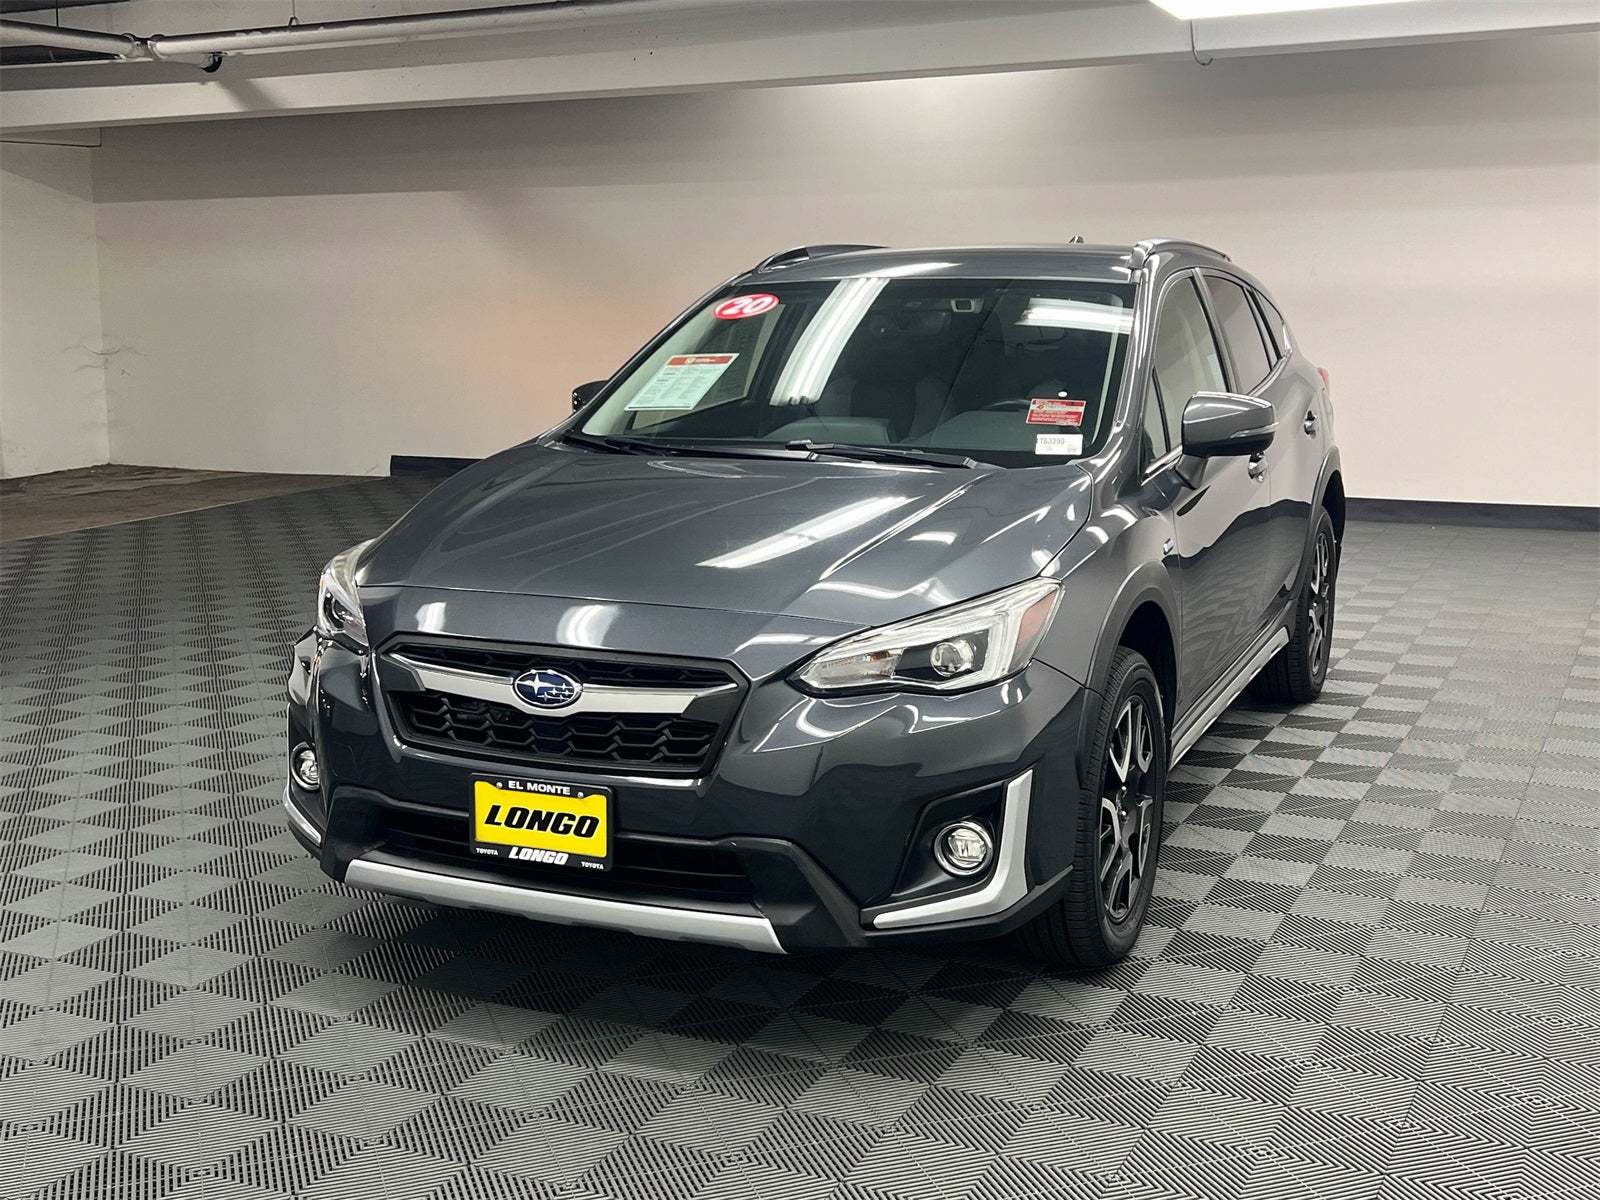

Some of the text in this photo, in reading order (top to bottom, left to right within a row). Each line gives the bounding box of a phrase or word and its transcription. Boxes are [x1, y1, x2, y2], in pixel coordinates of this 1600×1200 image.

[721, 296, 774, 316] 20
[508, 780, 571, 795] EL MONTE
[484, 804, 600, 839] LONGO
[475, 846, 604, 870] TOYOTA LONGO TOYOTA
